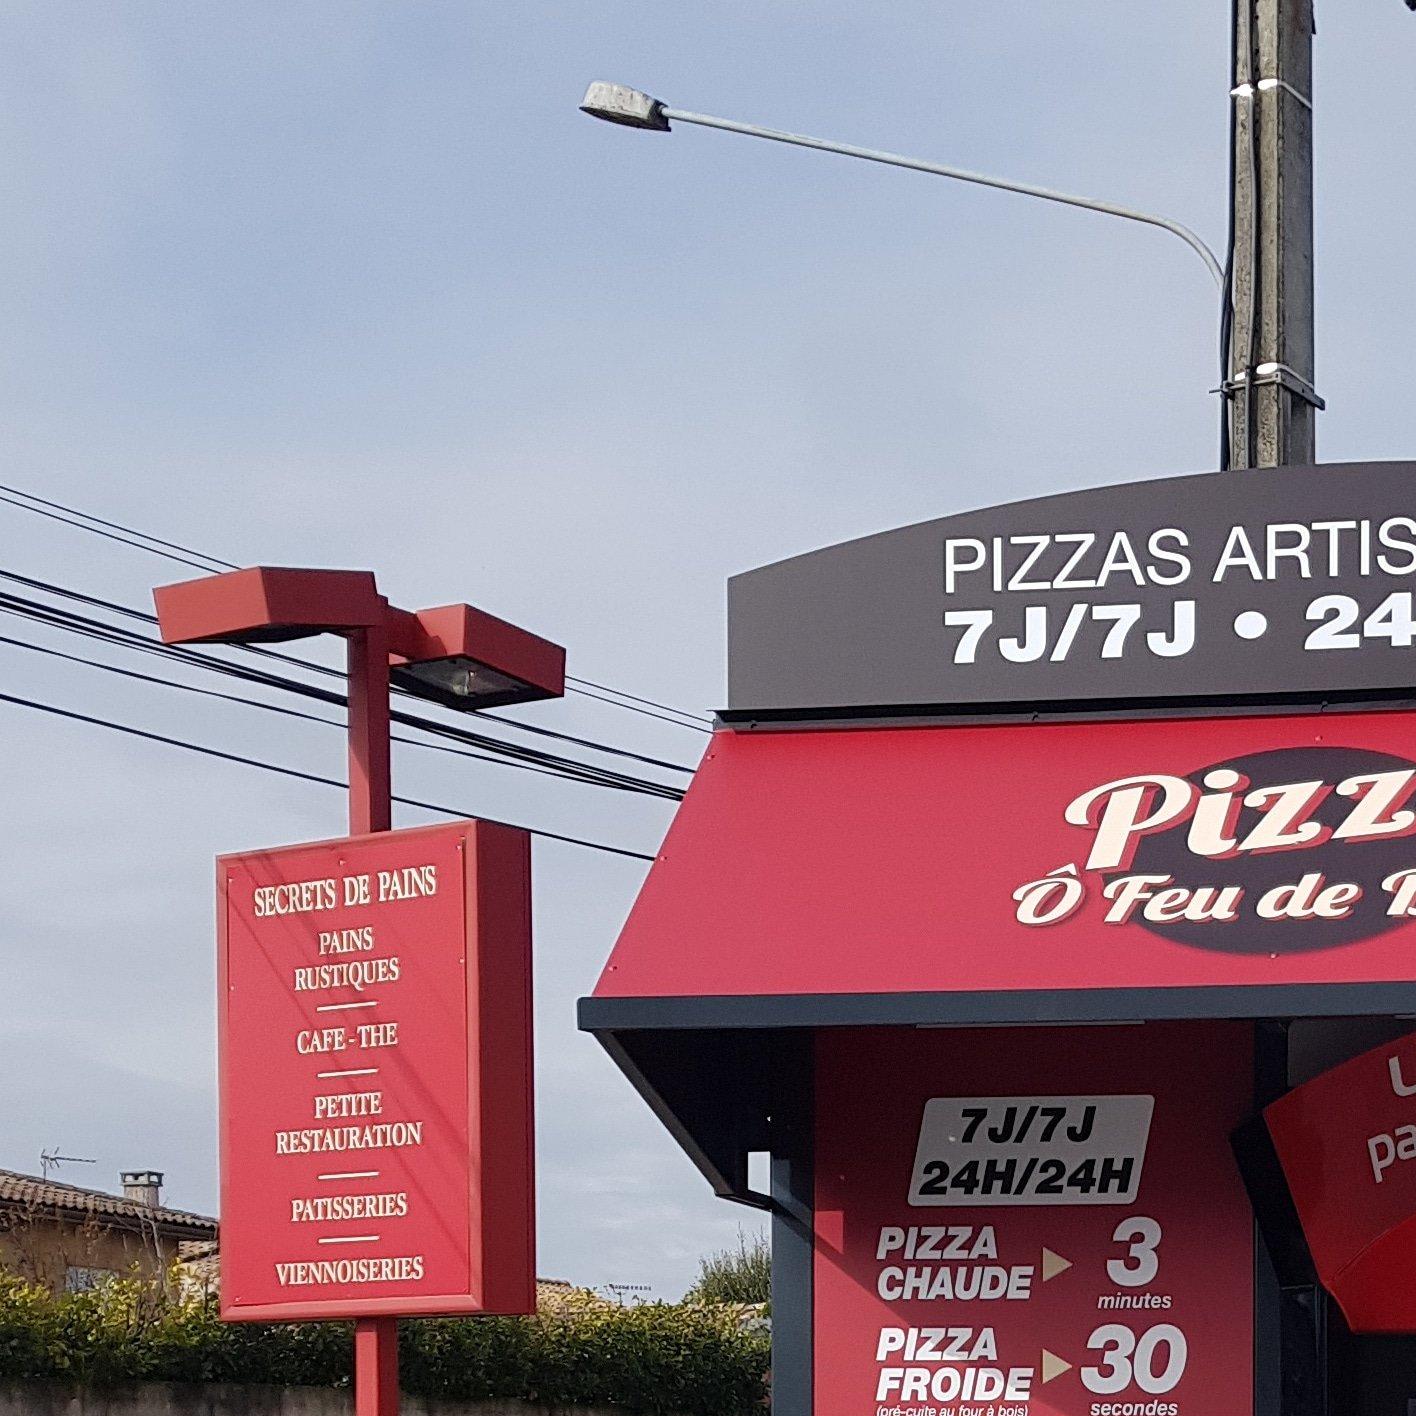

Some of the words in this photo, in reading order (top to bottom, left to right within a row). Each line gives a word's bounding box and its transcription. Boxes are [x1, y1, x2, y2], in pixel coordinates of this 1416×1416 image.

[943, 529, 1192, 593] PIZZAS
[943, 600, 1198, 665] 7J/7J
[253, 878, 337, 918] SECRETS
[343, 873, 371, 906] DE
[378, 865, 438, 901] PAINS
[1012, 862, 1085, 926] Ô
[1101, 872, 1240, 923] Feu
[1257, 869, 1360, 920] de
[318, 926, 375, 956] PAINS
[294, 957, 401, 992] RUSTIQUES
[314, 1090, 383, 1119] PETITE
[275, 1121, 424, 1156] RESTAURATION
[960, 1105, 1097, 1144] 7J/7J
[918, 1157, 1135, 1196] 24H/24H
[290, 1192, 408, 1222] PATISSERIES
[876, 1226, 998, 1260] PIZZA
[876, 1265, 1035, 1301] CHAUDE
[1105, 1215, 1163, 1287] 3
[275, 1256, 424, 1287] VIENNOISERIES
[1097, 1292, 1173, 1311] minutes
[876, 1327, 998, 1361] PIZZA
[875, 1367, 1035, 1402] FROIDE
[1079, 1323, 1189, 1395] 30
